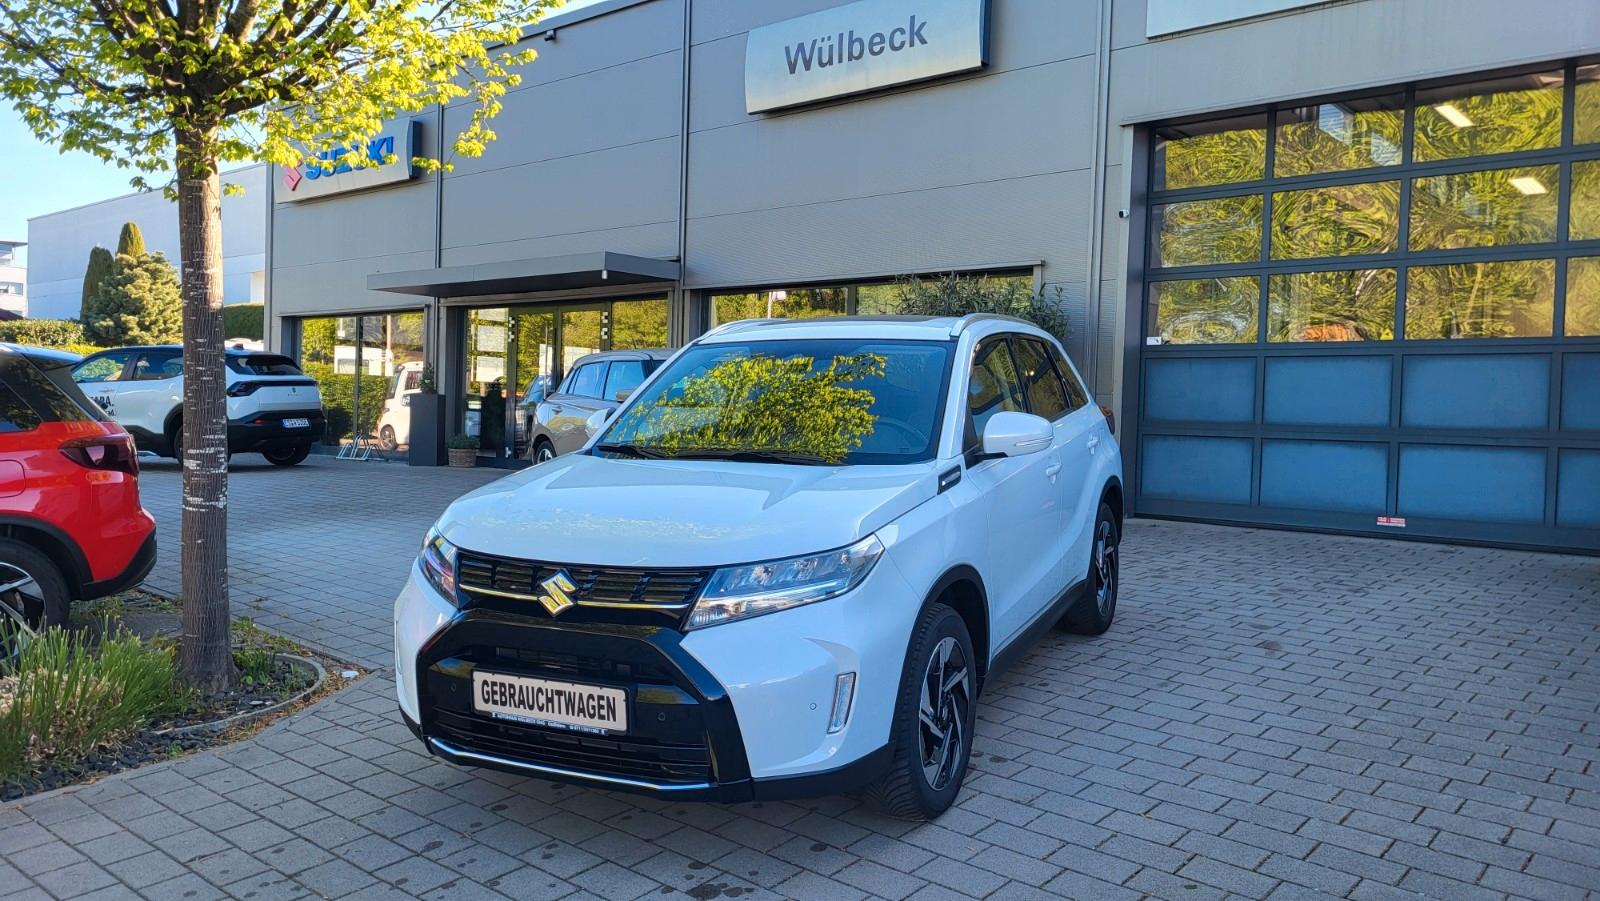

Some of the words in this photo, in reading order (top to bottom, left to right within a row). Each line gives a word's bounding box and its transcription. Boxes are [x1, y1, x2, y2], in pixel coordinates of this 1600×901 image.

[784, 15, 929, 75] Wülbeck
[305, 136, 394, 180] SUZKI
[481, 679, 617, 722] GEBRAUCHTWAGEN
